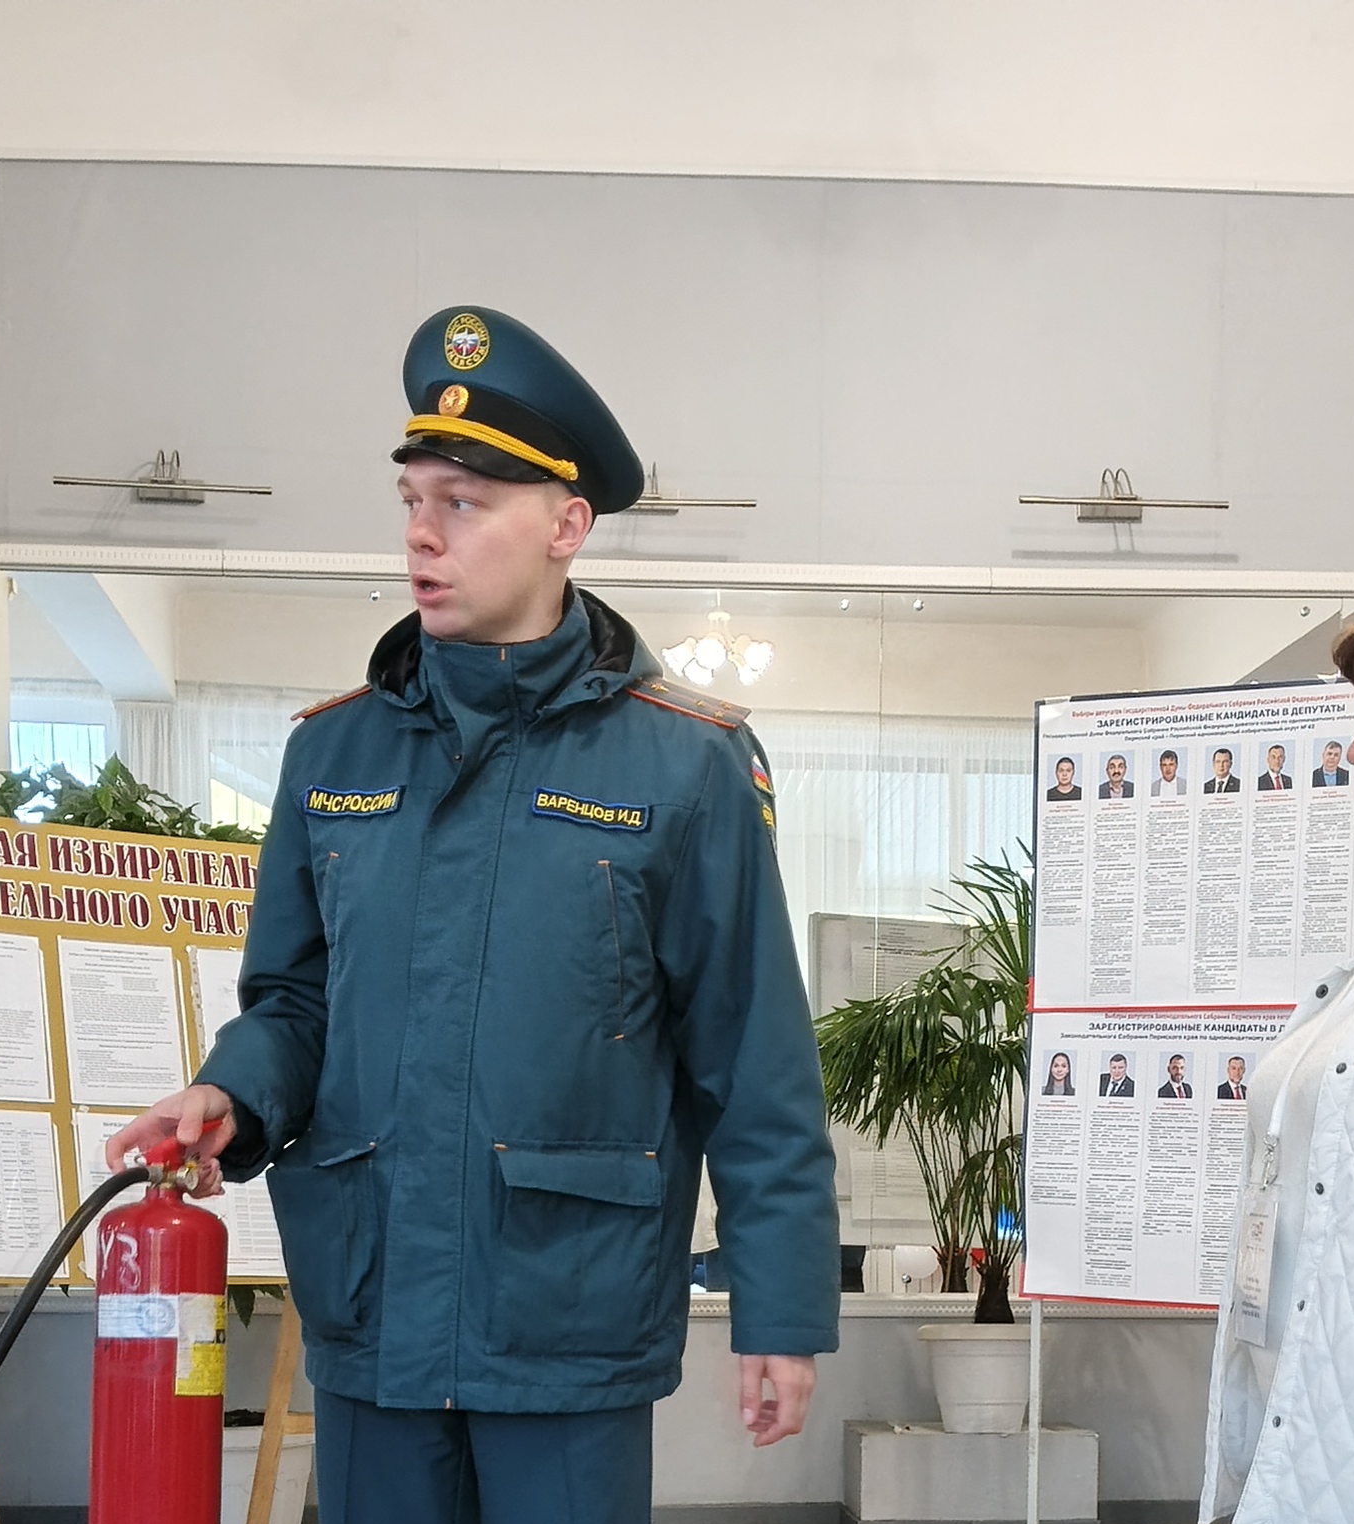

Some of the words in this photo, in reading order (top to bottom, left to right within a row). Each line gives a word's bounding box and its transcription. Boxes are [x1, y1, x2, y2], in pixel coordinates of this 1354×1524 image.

[1097, 713, 1214, 728] ЗАРЕГИСТРИРОВАННЫЕ
[1215, 708, 1281, 721] КАНДИДАТЫ
[1282, 708, 1290, 716] В
[1291, 704, 1346, 716] ДЕПУТАТЫ
[537, 793, 615, 822] ВАРЕНЦОВ
[1089, 1022, 1202, 1032] ЗАРЕГИСТРИРОВАННЫЕ
[1203, 1024, 1268, 1032] КАНДИДАТЫ
[1269, 1024, 1276, 1032] В
